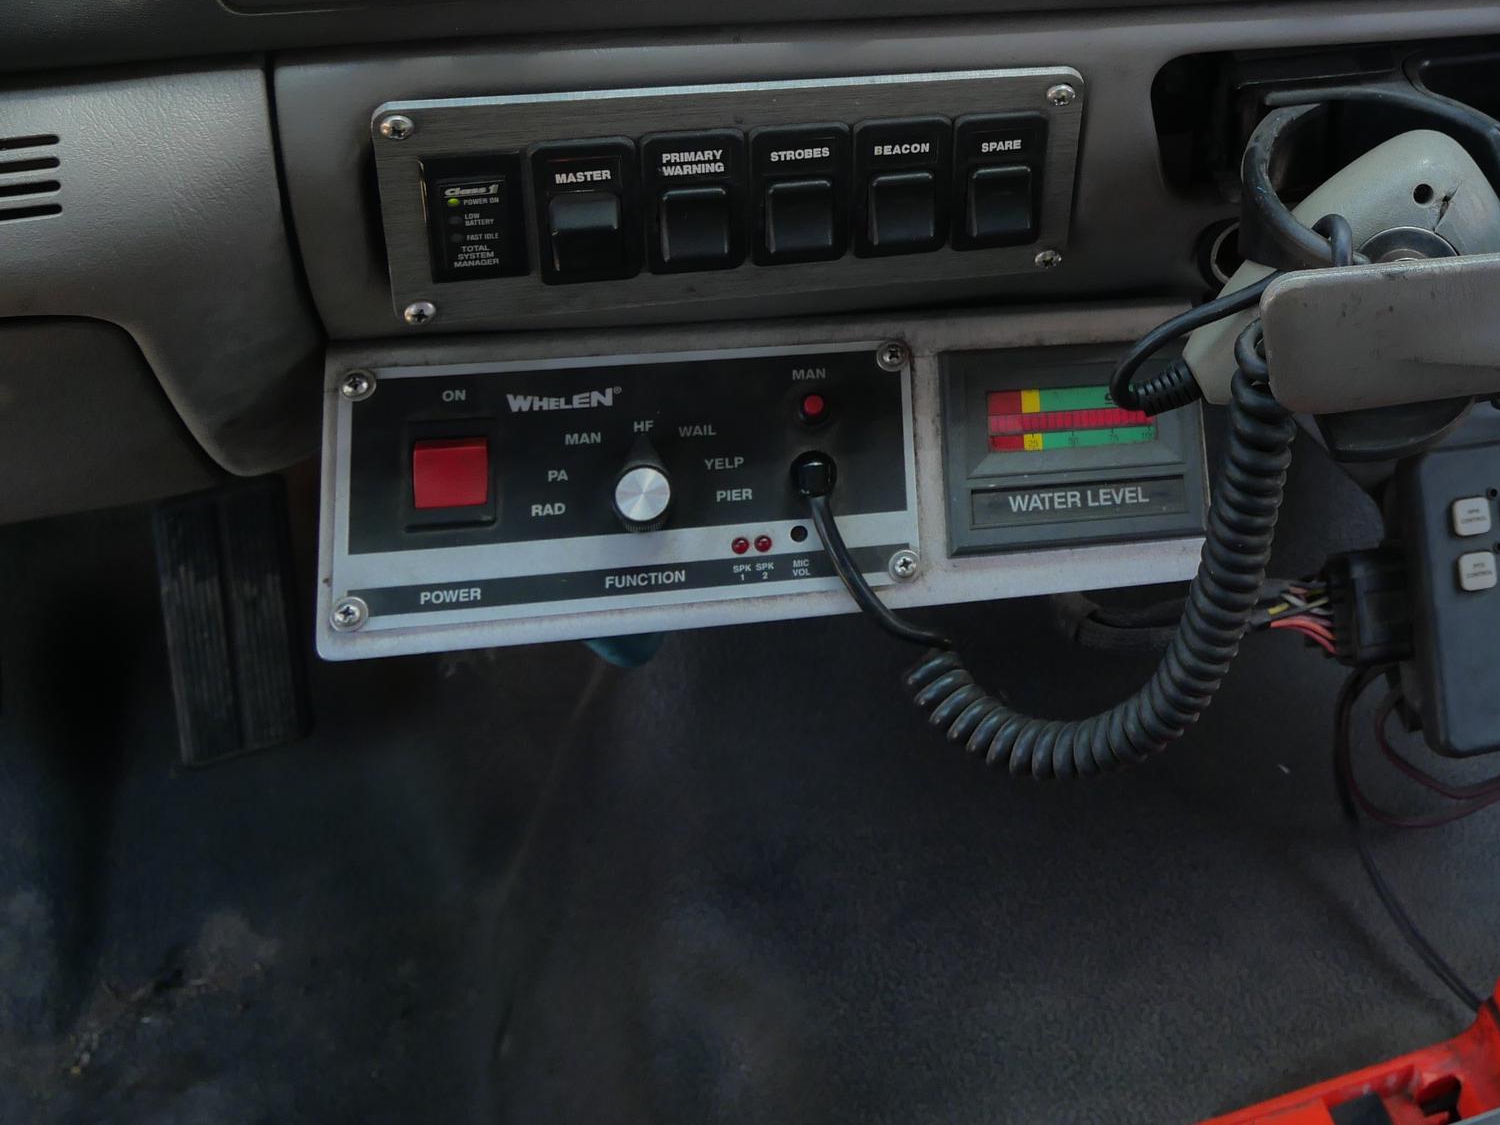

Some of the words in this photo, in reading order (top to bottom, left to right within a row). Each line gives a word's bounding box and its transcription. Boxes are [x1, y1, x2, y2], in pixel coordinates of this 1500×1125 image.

[873, 142, 930, 156] BEACON
[980, 138, 1022, 153] SPARE
[661, 148, 723, 166] PRIMARY
[770, 146, 830, 163] STROBES
[661, 161, 725, 177] WARNING
[554, 169, 611, 185] MASTER
[465, 218, 494, 226] BATTERY
[466, 233, 483, 241] FAST
[484, 232, 500, 240] IDLE
[461, 244, 490, 252] TOTAL
[458, 251, 495, 260] SYSTEM
[453, 258, 499, 268] MANAGER
[791, 368, 827, 381] MAN
[441, 389, 466, 402] ON
[633, 420, 654, 432] HF
[678, 424, 717, 437] WAIL
[564, 432, 601, 445] MAN
[704, 456, 745, 470] YELP
[547, 469, 568, 482] PA
[716, 488, 753, 502] PIER
[1008, 490, 1082, 513] WATER
[1087, 486, 1150, 508] LEVEL
[531, 503, 566, 517] RAD
[732, 563, 752, 573] SPK
[755, 562, 774, 571] SPK
[792, 559, 810, 568] MIC
[604, 569, 686, 589] FUNCTION
[740, 573, 745, 581] 1
[792, 568, 811, 577] VOL
[420, 587, 482, 606] POWER
